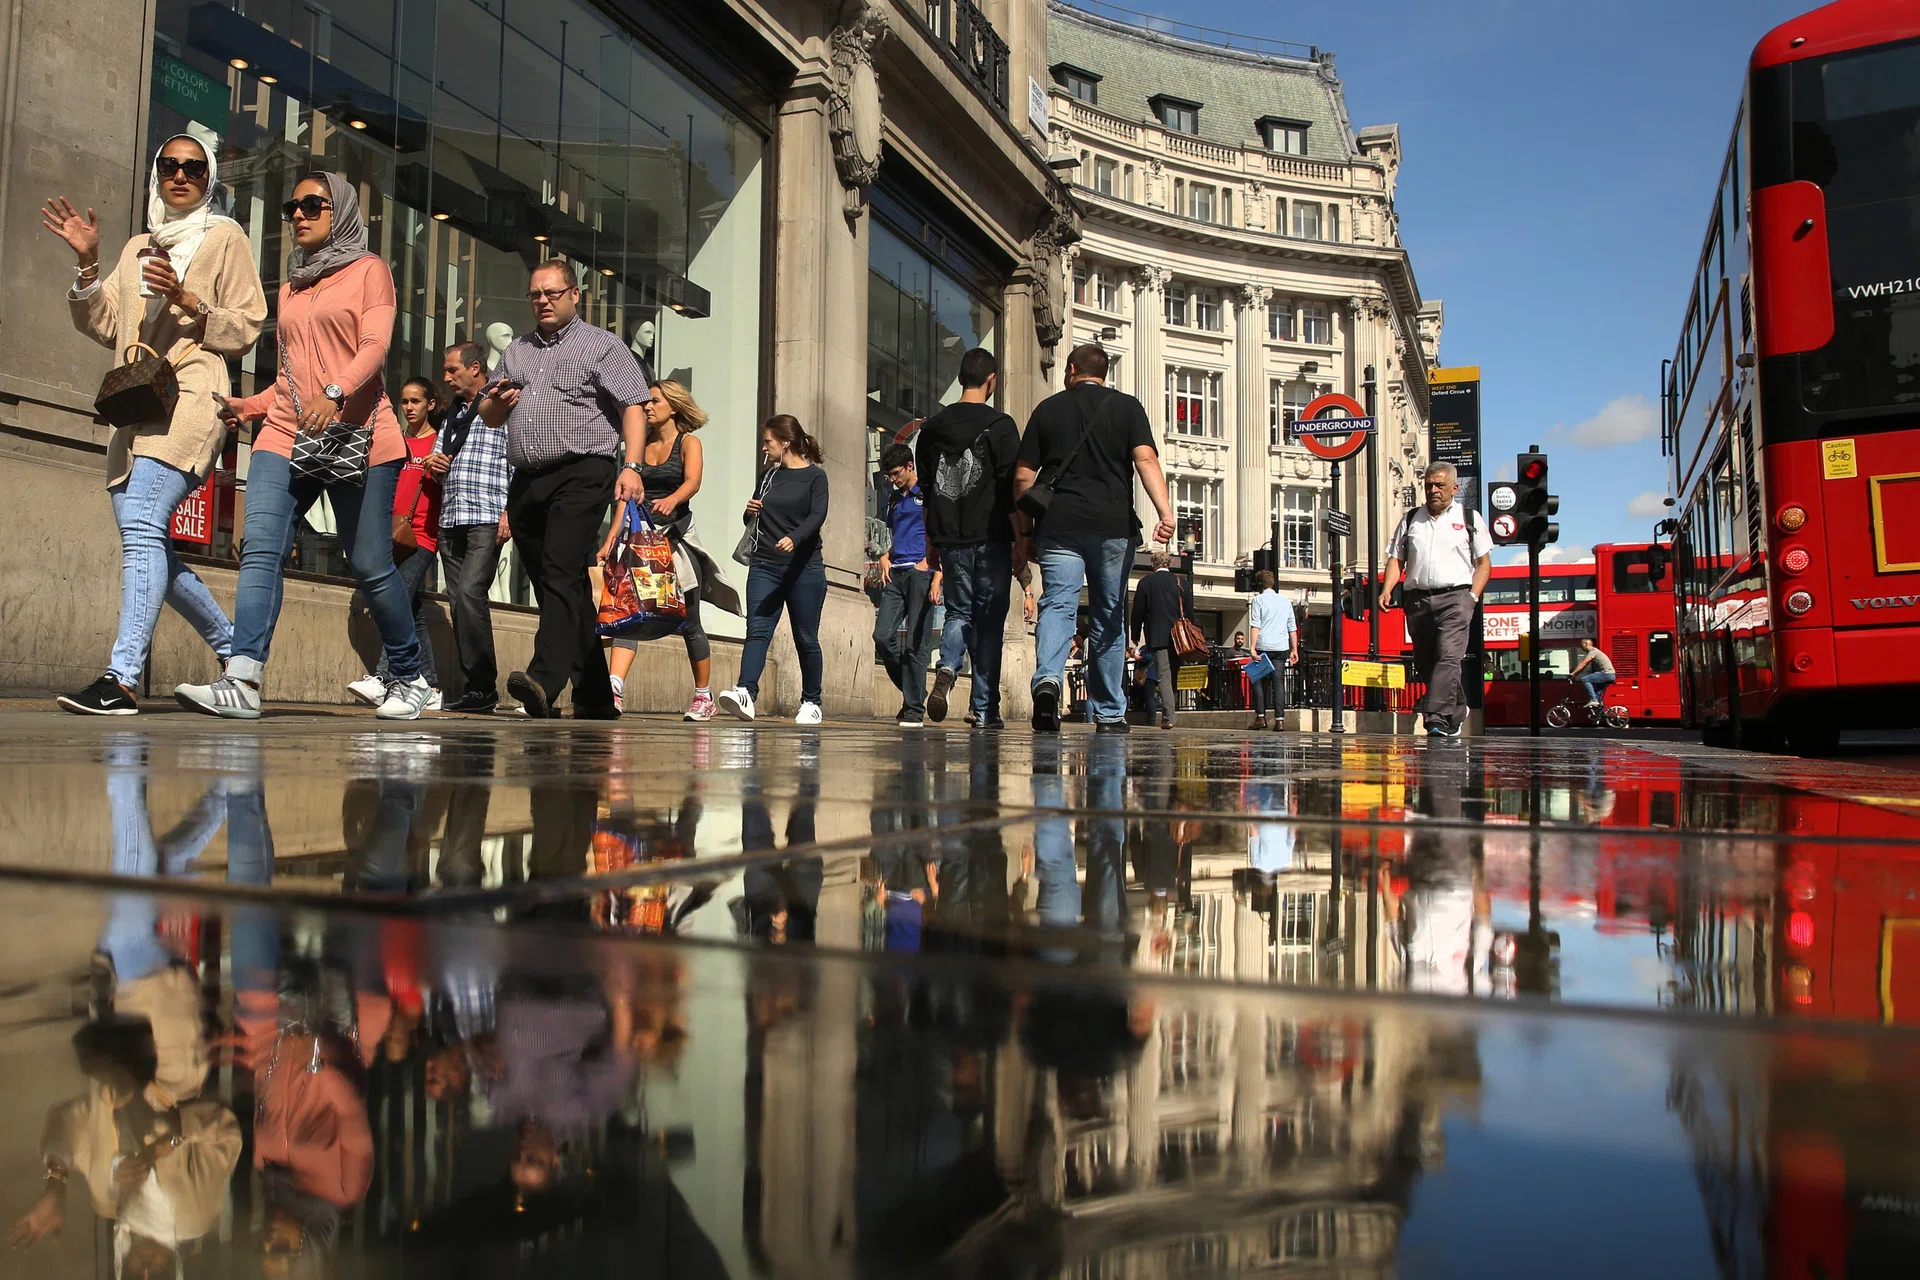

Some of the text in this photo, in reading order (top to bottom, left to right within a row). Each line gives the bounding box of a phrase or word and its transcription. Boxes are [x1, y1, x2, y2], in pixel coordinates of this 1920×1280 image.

[170, 64, 209, 93] COLORS
[1294, 420, 1371, 432] UNDERGROUND
[175, 515, 205, 538] SALE
